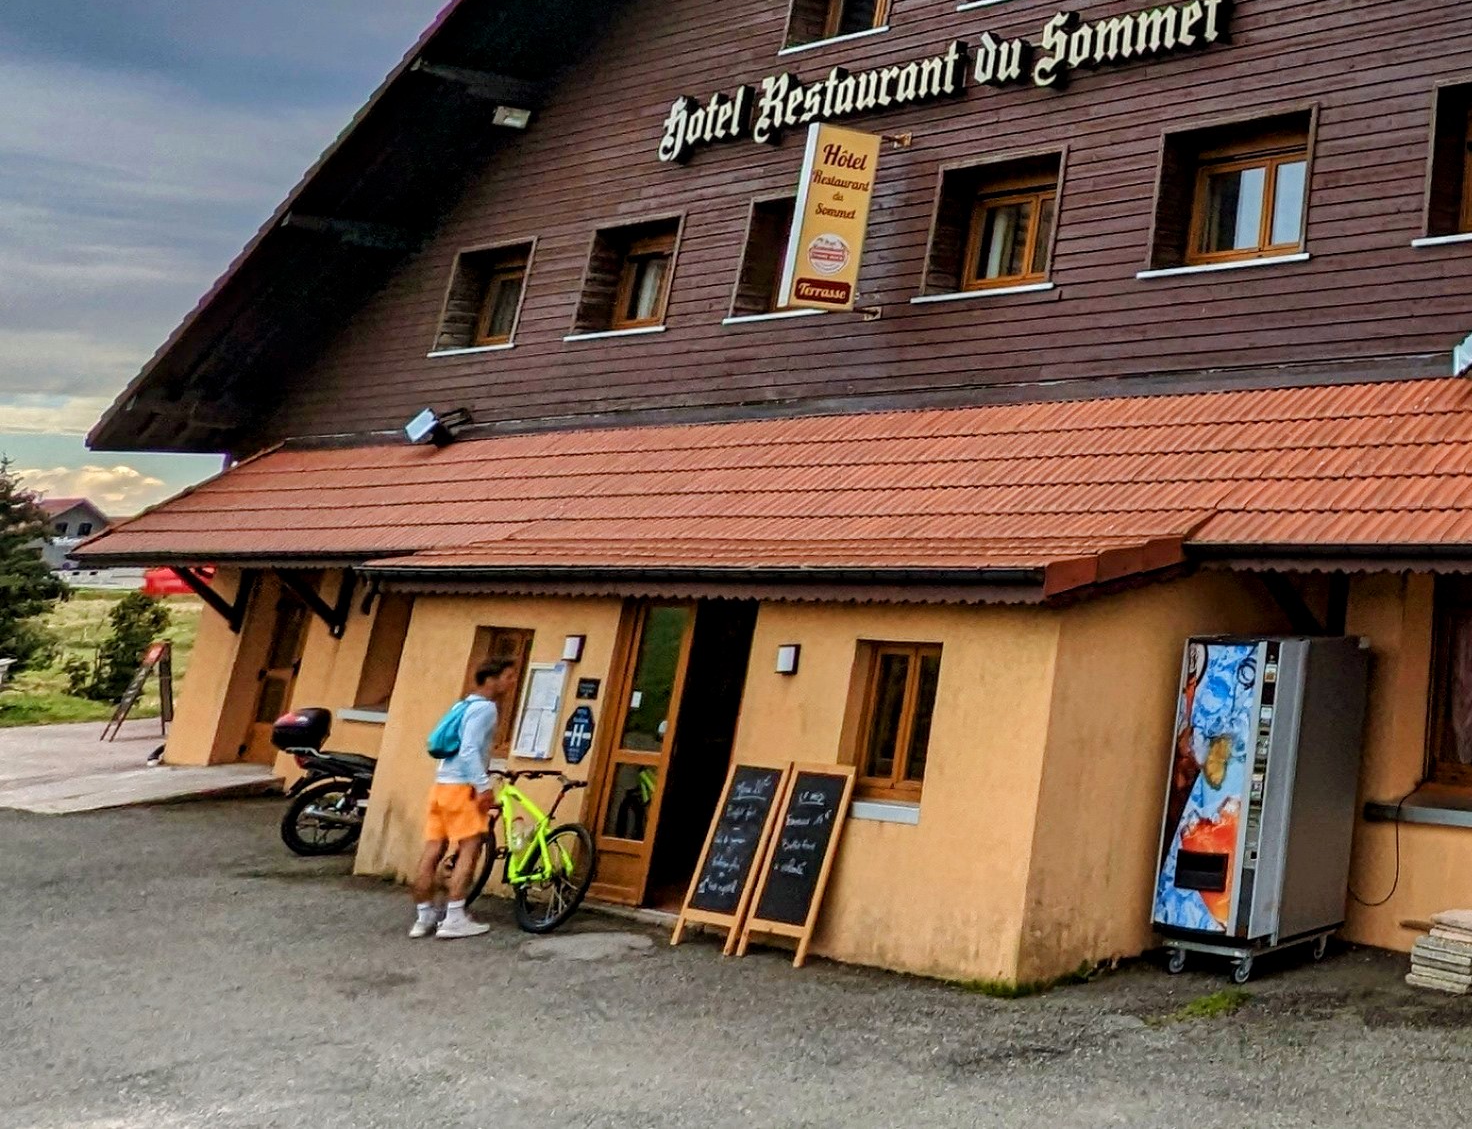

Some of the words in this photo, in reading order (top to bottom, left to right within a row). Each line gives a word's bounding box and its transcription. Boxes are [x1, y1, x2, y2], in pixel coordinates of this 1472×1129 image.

[657, 85, 744, 162] Hotel
[754, 40, 961, 144] Restaurant
[974, 31, 1021, 85] du
[823, 143, 868, 171] Hôtel
[812, 169, 870, 192] Restaurant
[832, 191, 844, 202] du
[815, 202, 856, 220] Sommet
[798, 282, 846, 300] Terrasse
